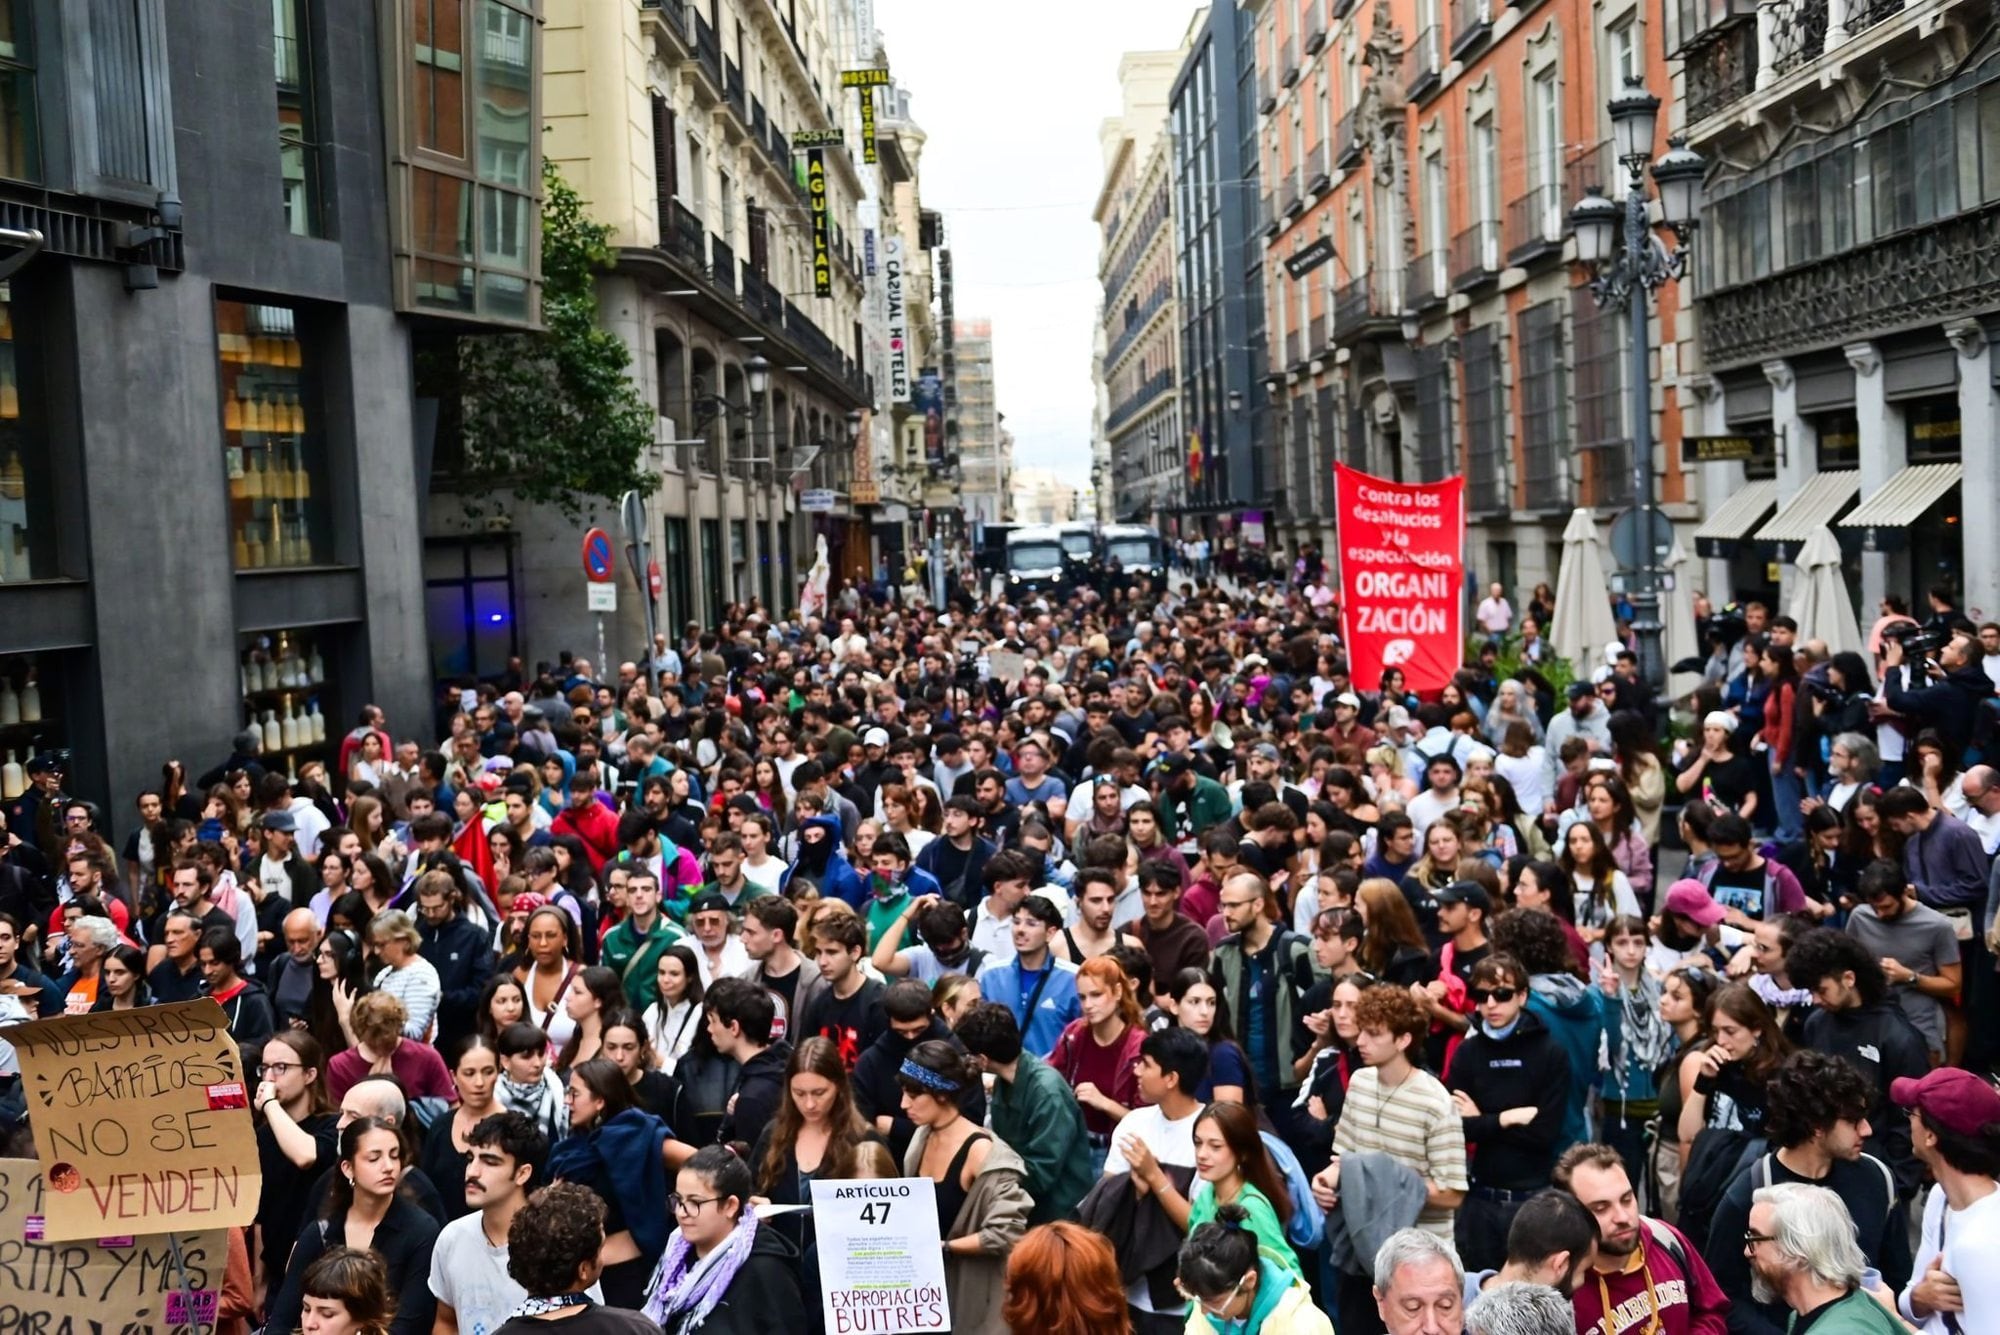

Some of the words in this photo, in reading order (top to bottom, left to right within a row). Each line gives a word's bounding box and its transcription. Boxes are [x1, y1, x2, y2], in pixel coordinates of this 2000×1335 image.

[842, 71, 888, 84] HOSTAL
[792, 130, 842, 143] HOSTAL
[861, 87, 876, 156] VICTORIA
[809, 160, 829, 284] AGUILAR
[886, 260, 902, 321] CASUAL
[1358, 485, 1412, 507] Contra
[1415, 491, 1440, 507] los
[1353, 504, 1441, 528] desahucios
[1381, 531, 1392, 547] y
[1393, 529, 1410, 547] la
[1356, 571, 1449, 599] ORGANI
[1357, 602, 1447, 635] ZACIÓN
[14, 1007, 216, 1058] NUESTROS
[57, 1051, 226, 1108] BARRIOS
[48, 1118, 129, 1160] NO
[150, 1108, 217, 1152] SE
[85, 1165, 238, 1220] VENDEN
[835, 1183, 910, 1198] ARTÍCULO
[859, 1202, 891, 1225] 47
[174, 1294, 212, 1308] AAB
[831, 1281, 942, 1308] EXPROPIACIÓN
[1586, 1280, 1688, 1335] MBRDGE
[836, 1302, 943, 1334] BUITRES
